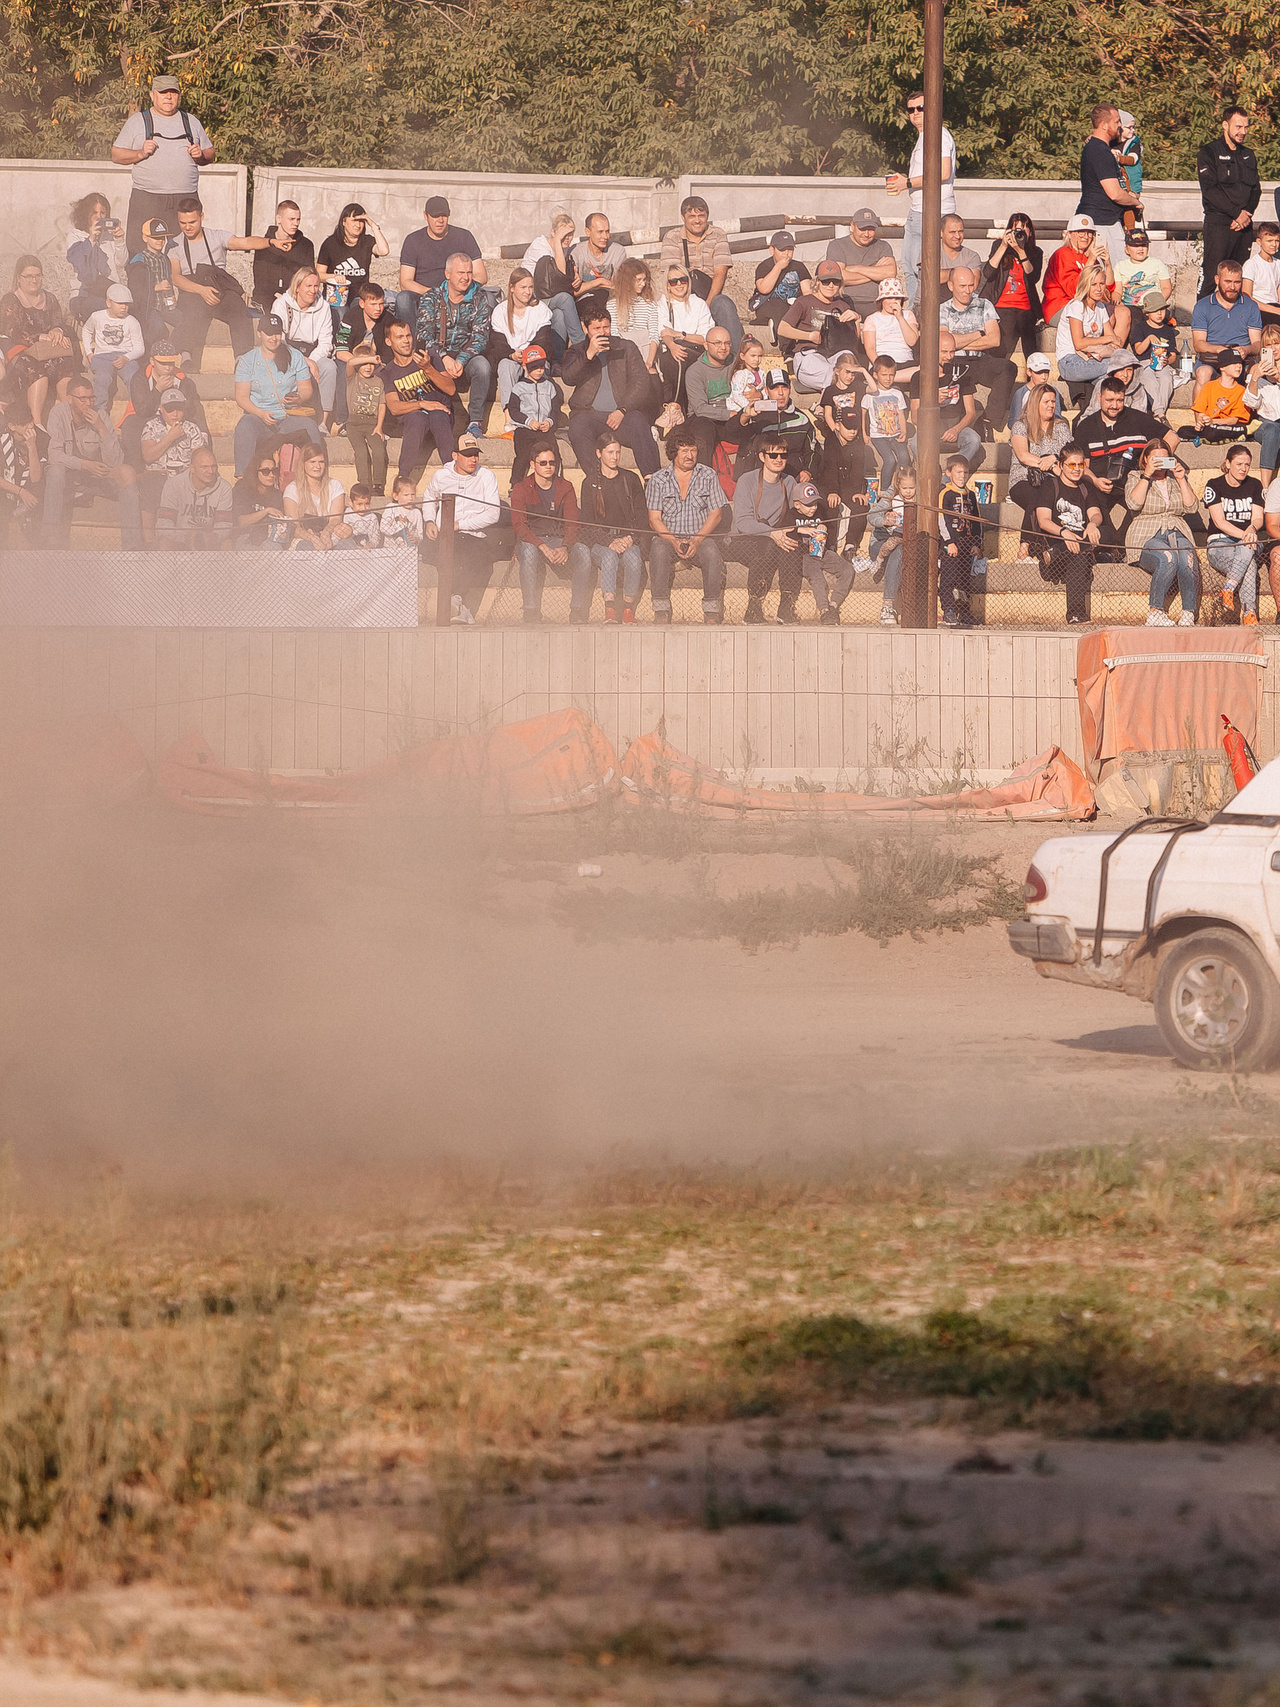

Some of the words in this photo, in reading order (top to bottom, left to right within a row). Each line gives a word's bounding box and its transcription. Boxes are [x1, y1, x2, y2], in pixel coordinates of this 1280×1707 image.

[333, 267, 366, 277] adidas
[394, 369, 430, 392] PUMA
[181, 504, 215, 518] JAPAN
